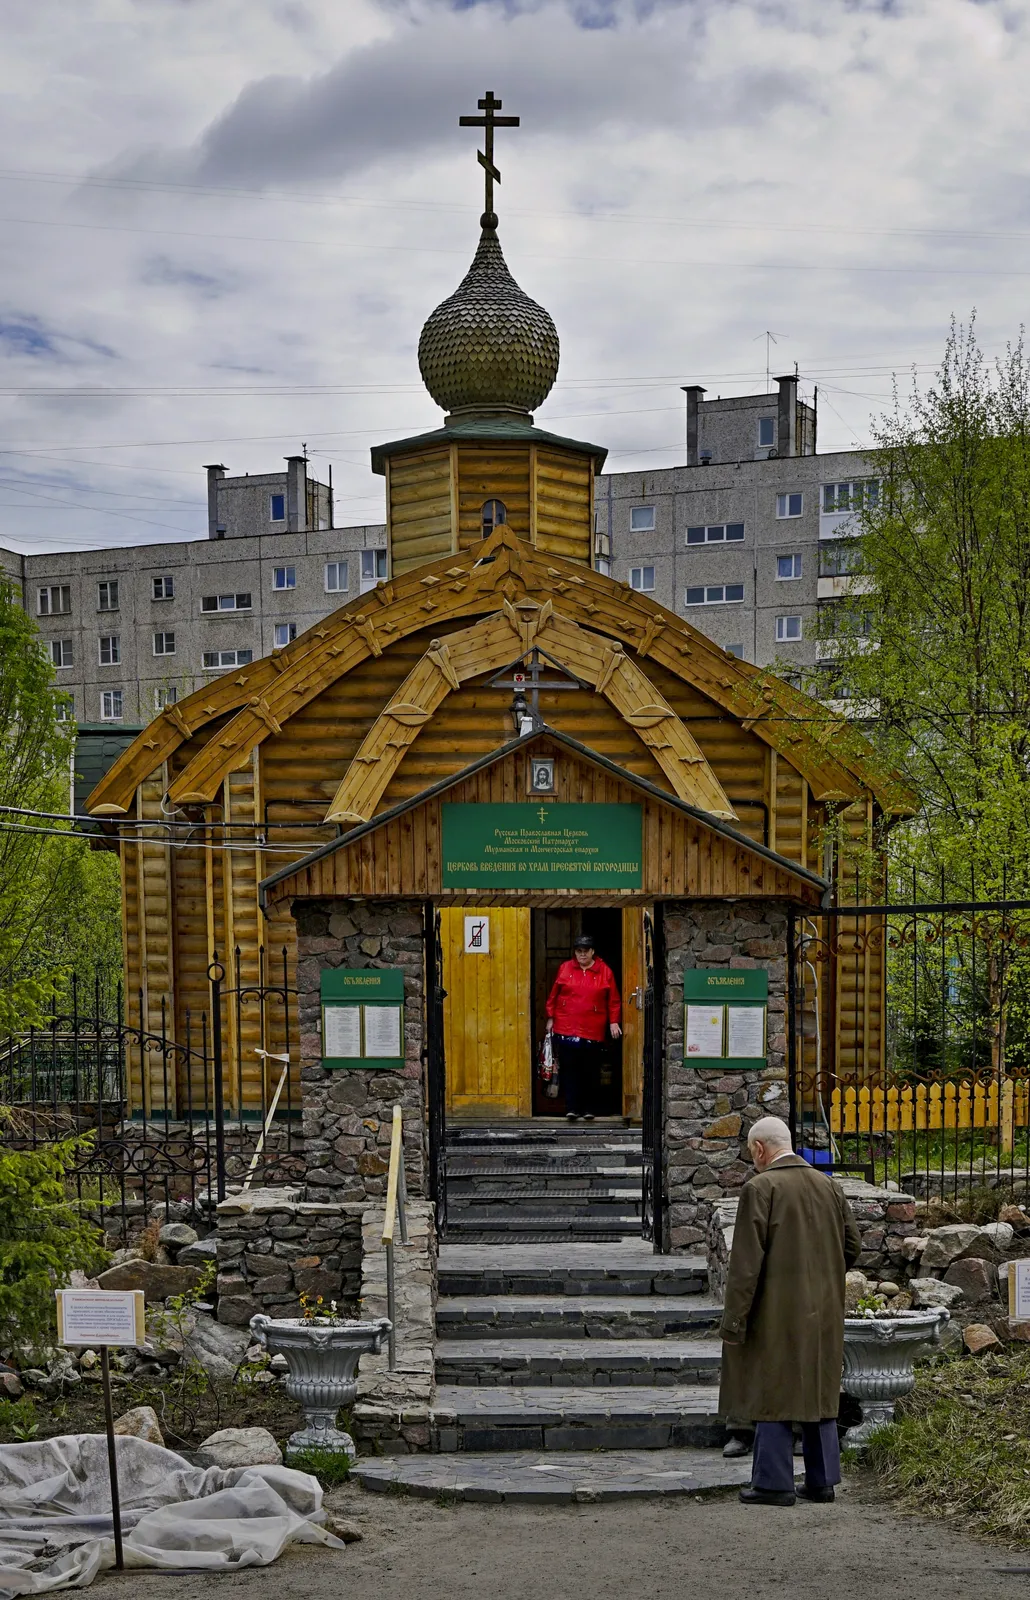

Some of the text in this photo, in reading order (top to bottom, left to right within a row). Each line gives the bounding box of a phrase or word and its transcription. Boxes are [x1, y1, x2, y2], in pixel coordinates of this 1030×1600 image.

[494, 828, 589, 838] Русская Православная Церковь
[504, 837, 579, 846] Московский Патриархат
[484, 845, 523, 855] Мурманская
[530, 845, 573, 855] Мончегорская
[574, 847, 599, 855] епархия
[447, 860, 639, 874] ЦЕРКОВЬ ВВЕДЕНИЯ ВО ХРАМ ПРЕСВЯТОЙ БОГОРОДИЦЫ
